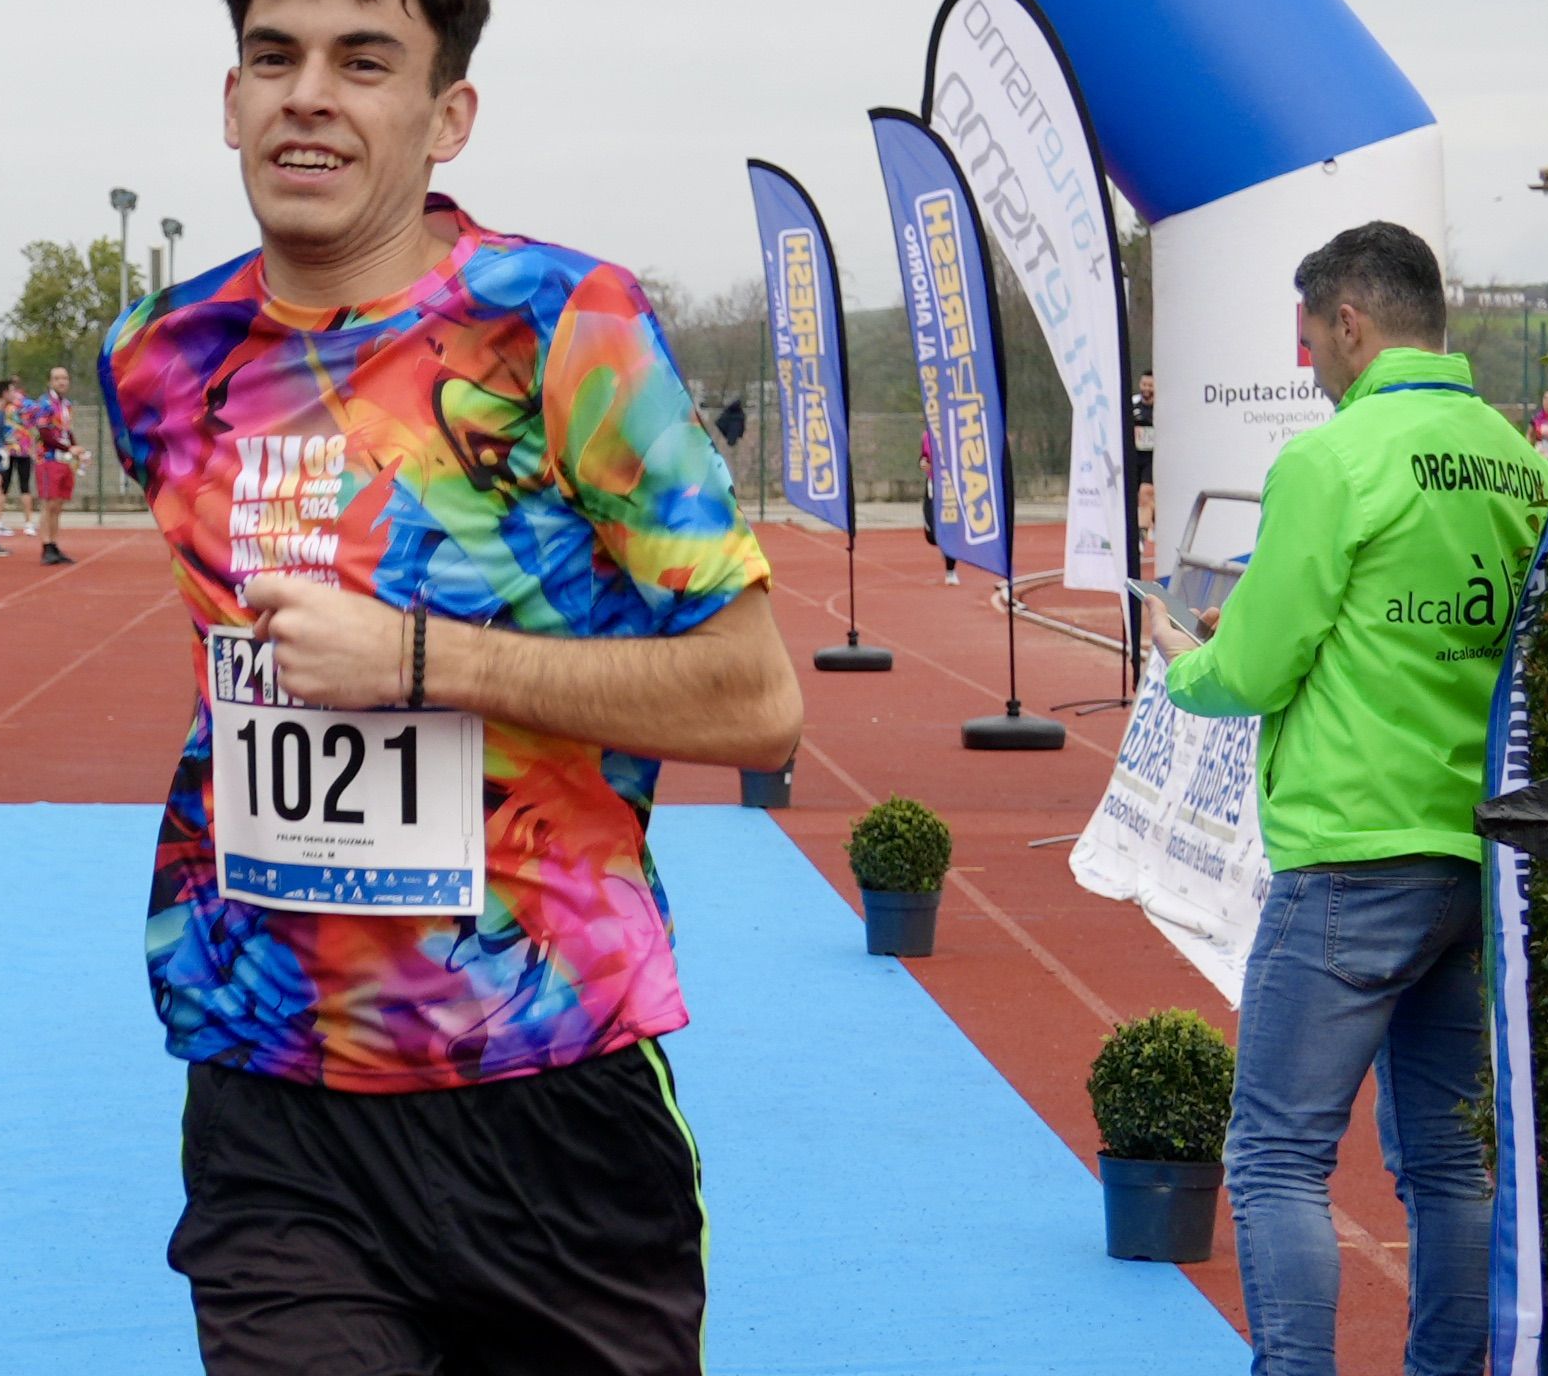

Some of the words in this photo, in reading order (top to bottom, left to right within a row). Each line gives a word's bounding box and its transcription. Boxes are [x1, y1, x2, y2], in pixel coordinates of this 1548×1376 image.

[1204, 380, 1325, 407] Diputación
[232, 435, 303, 502] XII
[304, 434, 347, 478] 08
[1410, 452, 1545, 503] ORGANIZACIÓN
[229, 500, 301, 538] MEDIA
[300, 496, 340, 522] 2026
[230, 526, 340, 574] MARATÓN
[236, 717, 419, 827] 1021
